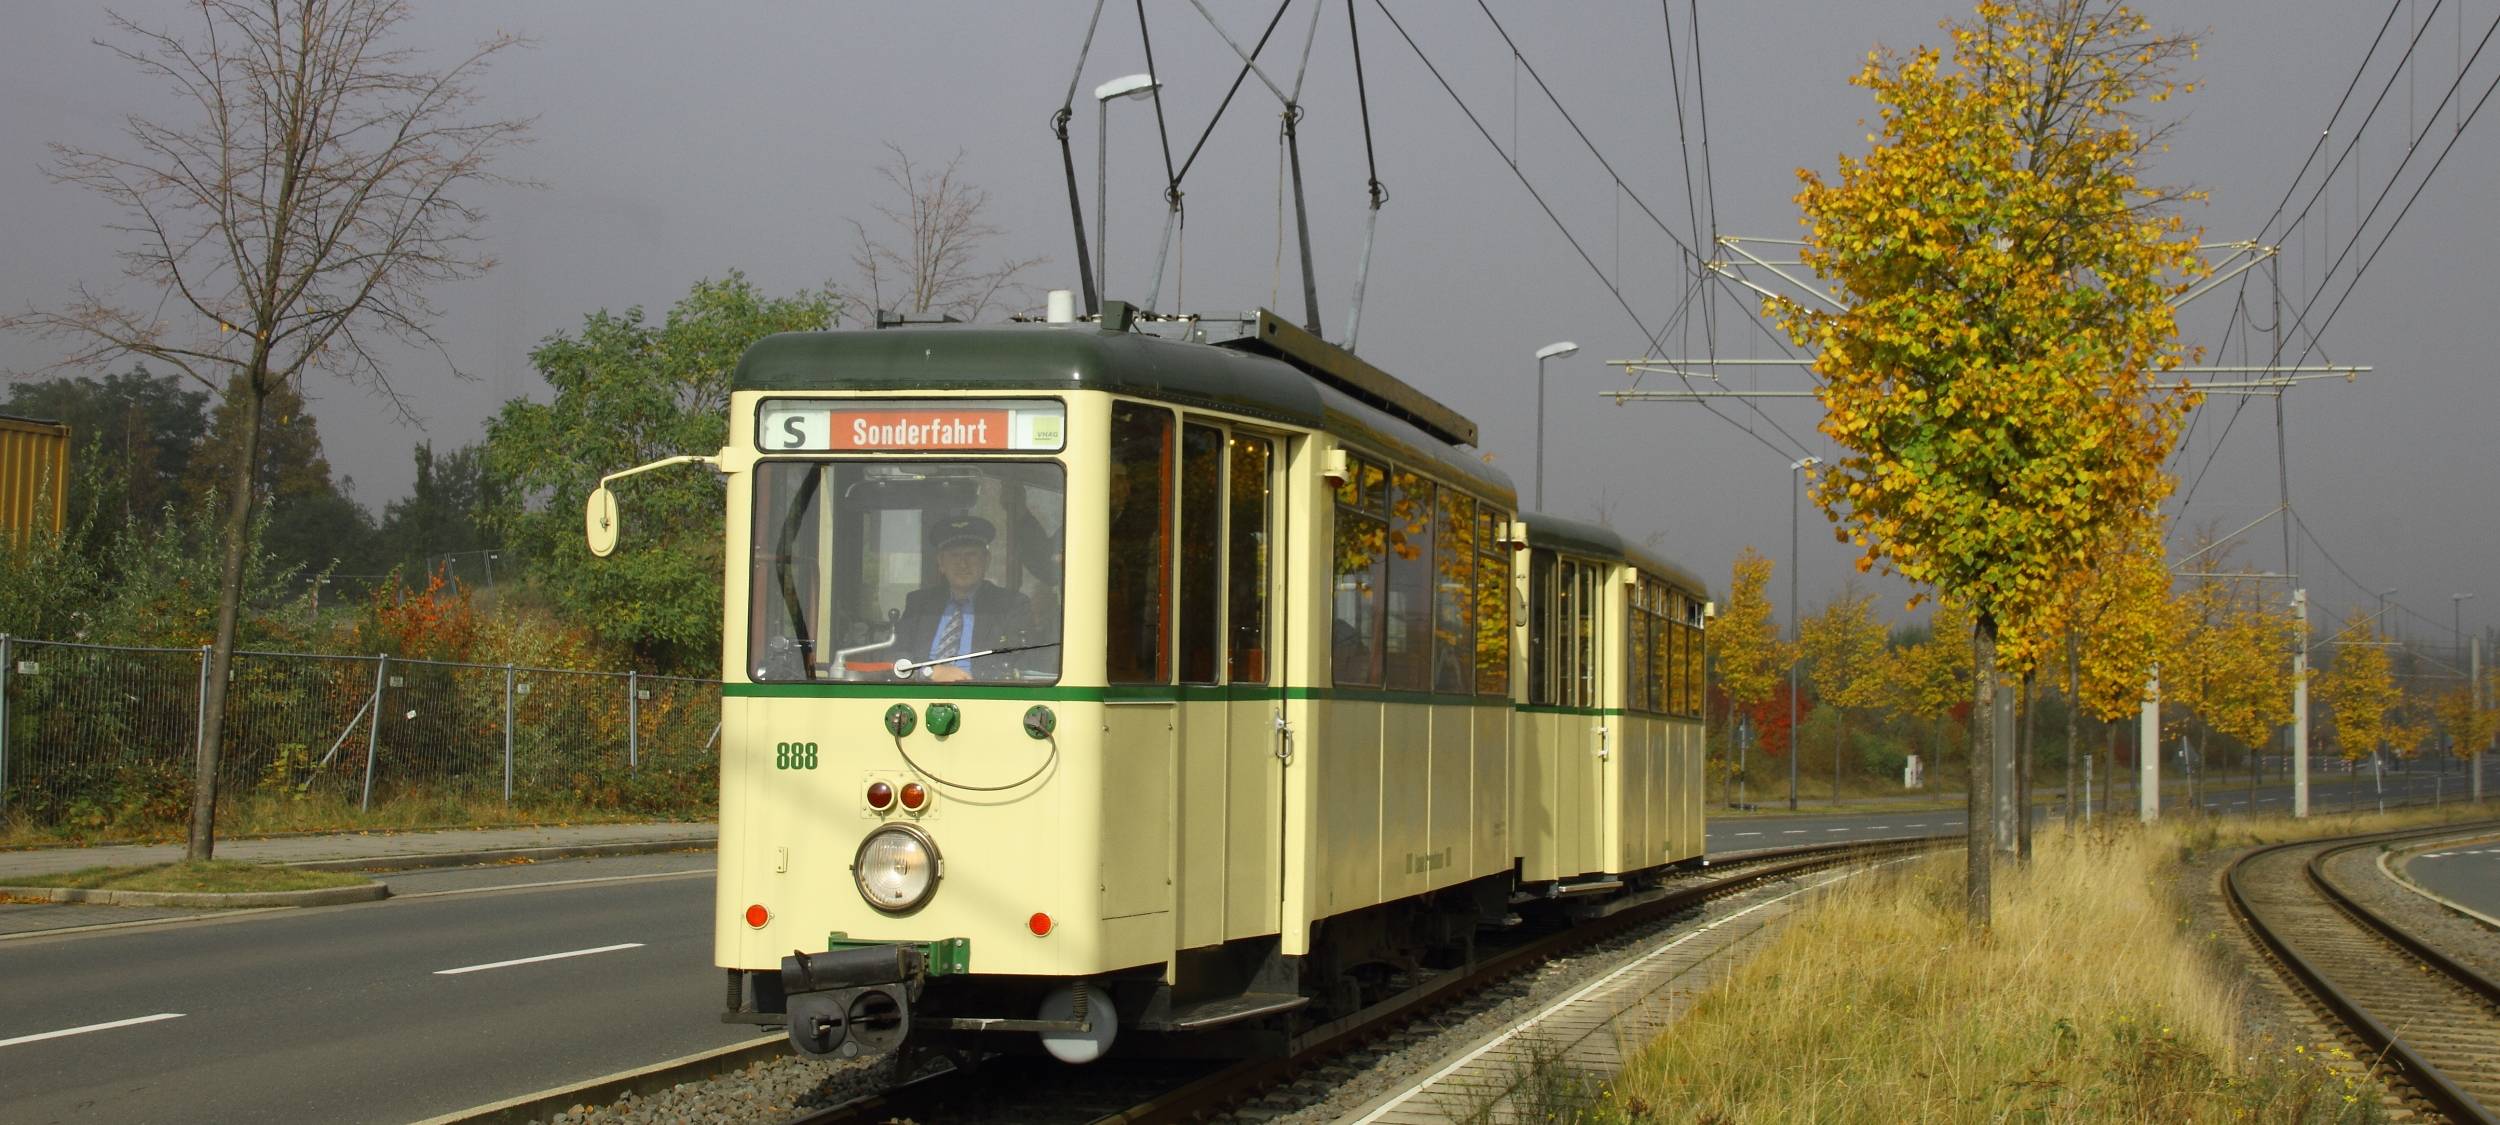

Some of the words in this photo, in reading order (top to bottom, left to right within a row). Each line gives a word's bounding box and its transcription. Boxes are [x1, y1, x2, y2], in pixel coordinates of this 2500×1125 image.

[783, 416, 806, 448] S
[853, 418, 987, 445] Sonderfahrt
[777, 742, 818, 770] 888
